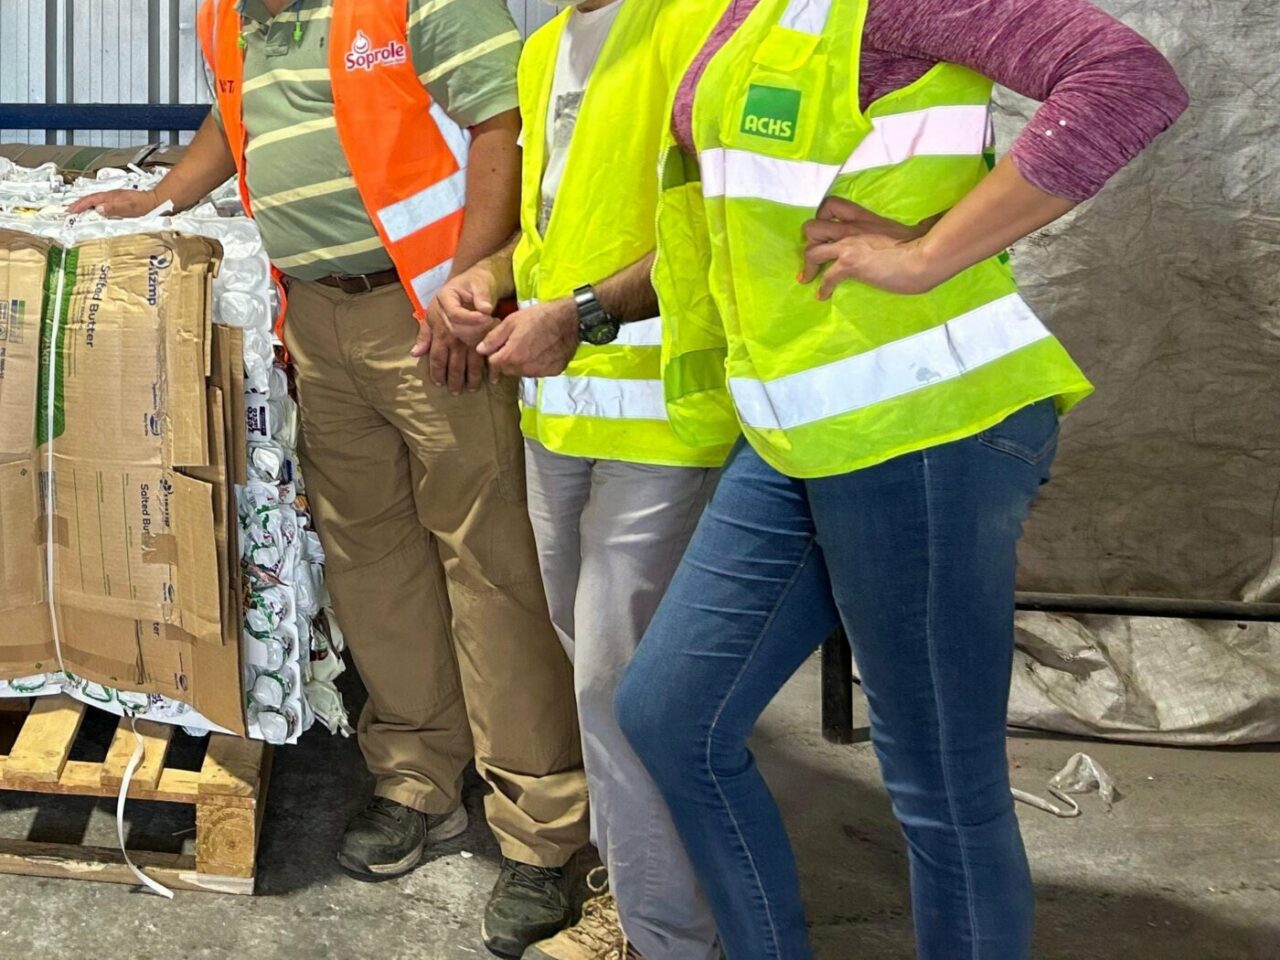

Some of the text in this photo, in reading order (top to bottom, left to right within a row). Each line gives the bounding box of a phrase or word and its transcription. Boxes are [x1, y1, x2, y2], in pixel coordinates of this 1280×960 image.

[346, 42, 404, 69] Soprole
[744, 114, 792, 137] ACHS
[147, 267, 159, 306] nzmp
[86, 264, 111, 348] Salted Butter
[140, 483, 150, 517] Salted
